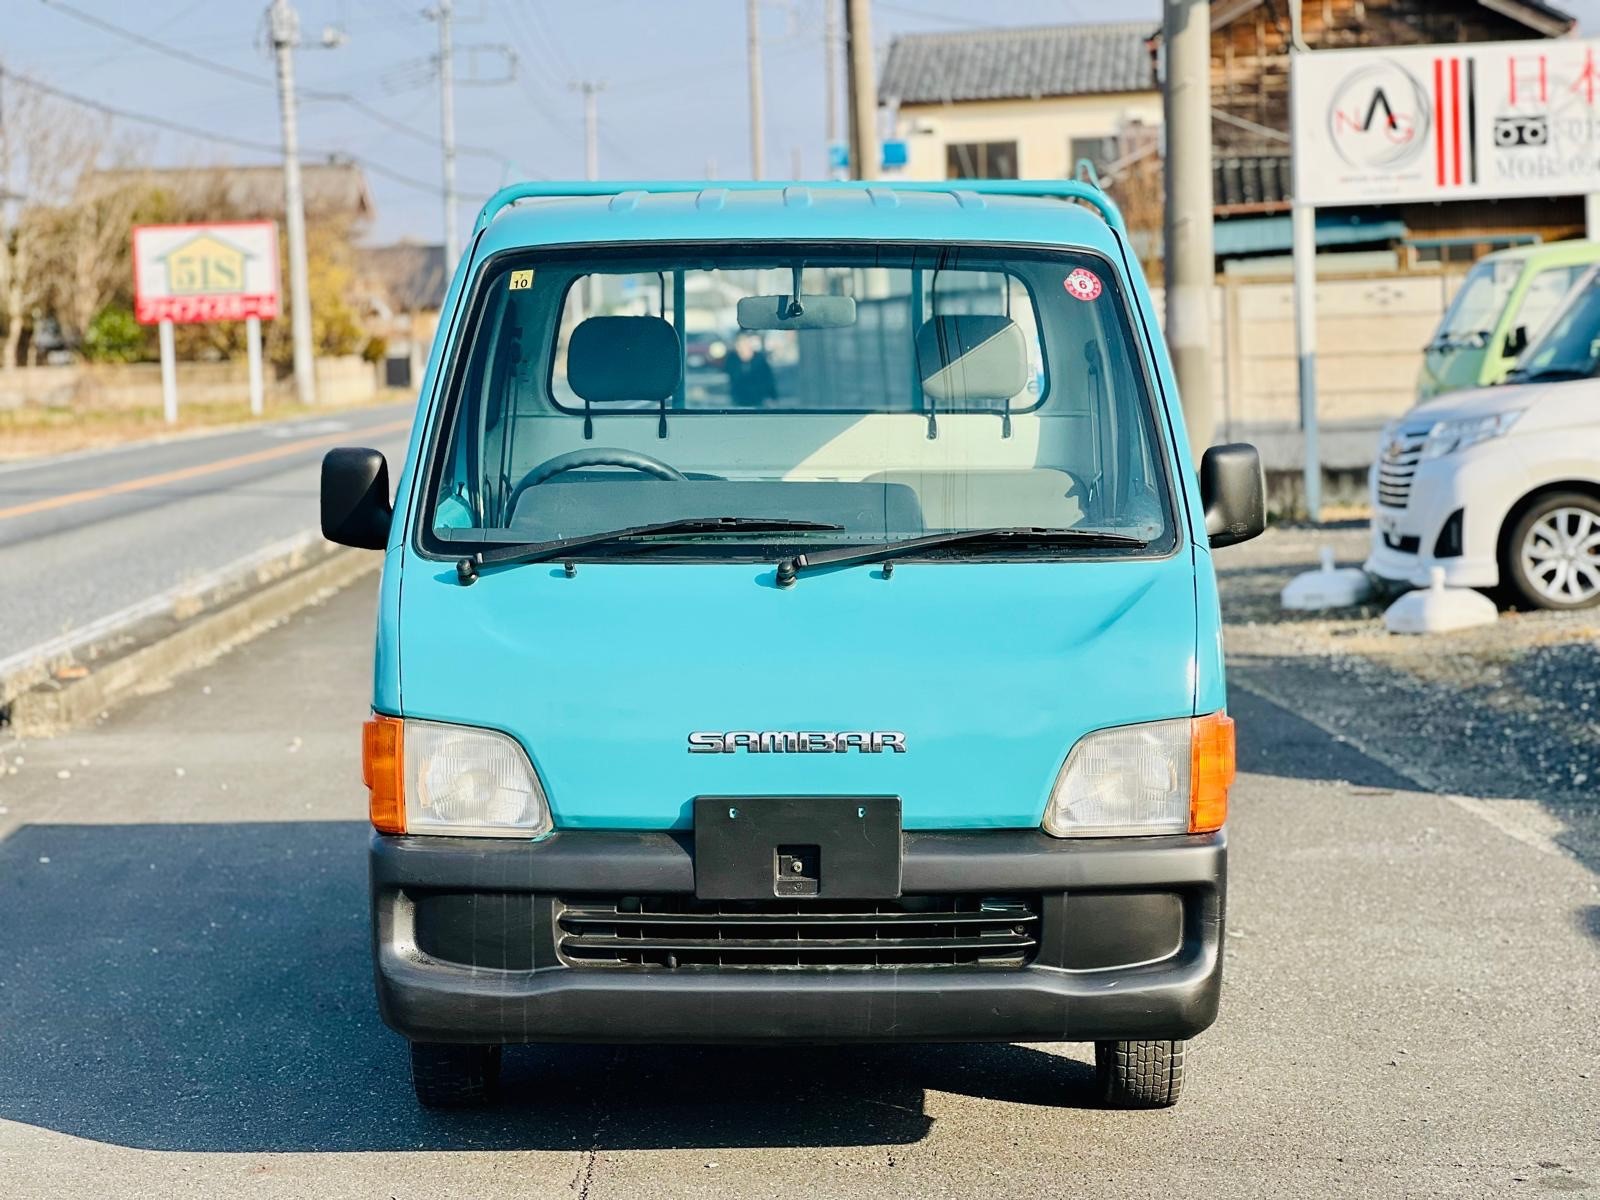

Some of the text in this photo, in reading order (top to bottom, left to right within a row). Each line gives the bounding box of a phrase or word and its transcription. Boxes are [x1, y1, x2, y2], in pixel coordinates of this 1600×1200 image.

[513, 279, 528, 289] 10
[1078, 280, 1088, 290] 6
[687, 731, 906, 753] SAMBAR
